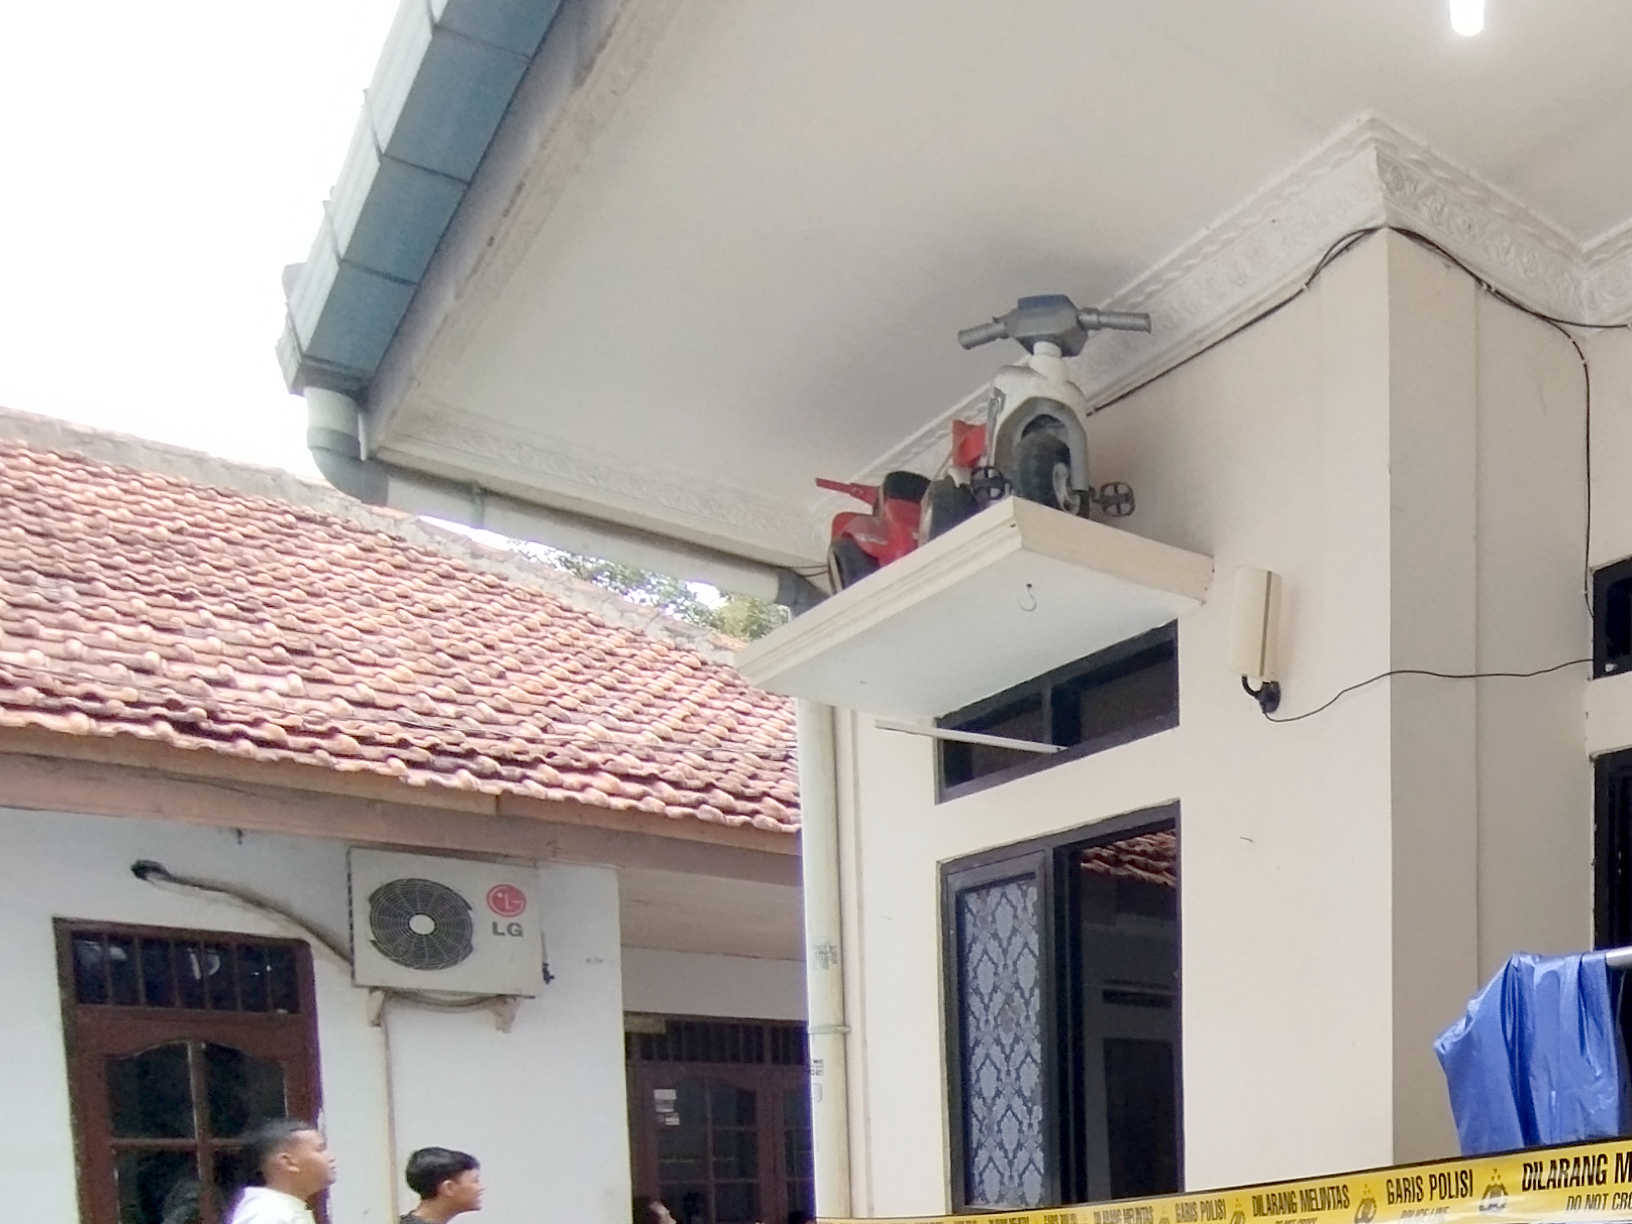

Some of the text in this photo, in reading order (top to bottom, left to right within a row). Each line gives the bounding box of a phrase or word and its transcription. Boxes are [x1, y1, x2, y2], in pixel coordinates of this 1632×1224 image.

[491, 921, 524, 938] LG
[1385, 1168, 1474, 1206] GARIS POLISI
[1521, 1153, 1609, 1193] DILARANG
[1251, 1184, 1350, 1217] DILARANG MELINTAS
[1565, 1195, 1582, 1211] DO
[1584, 1192, 1609, 1211] NOT
